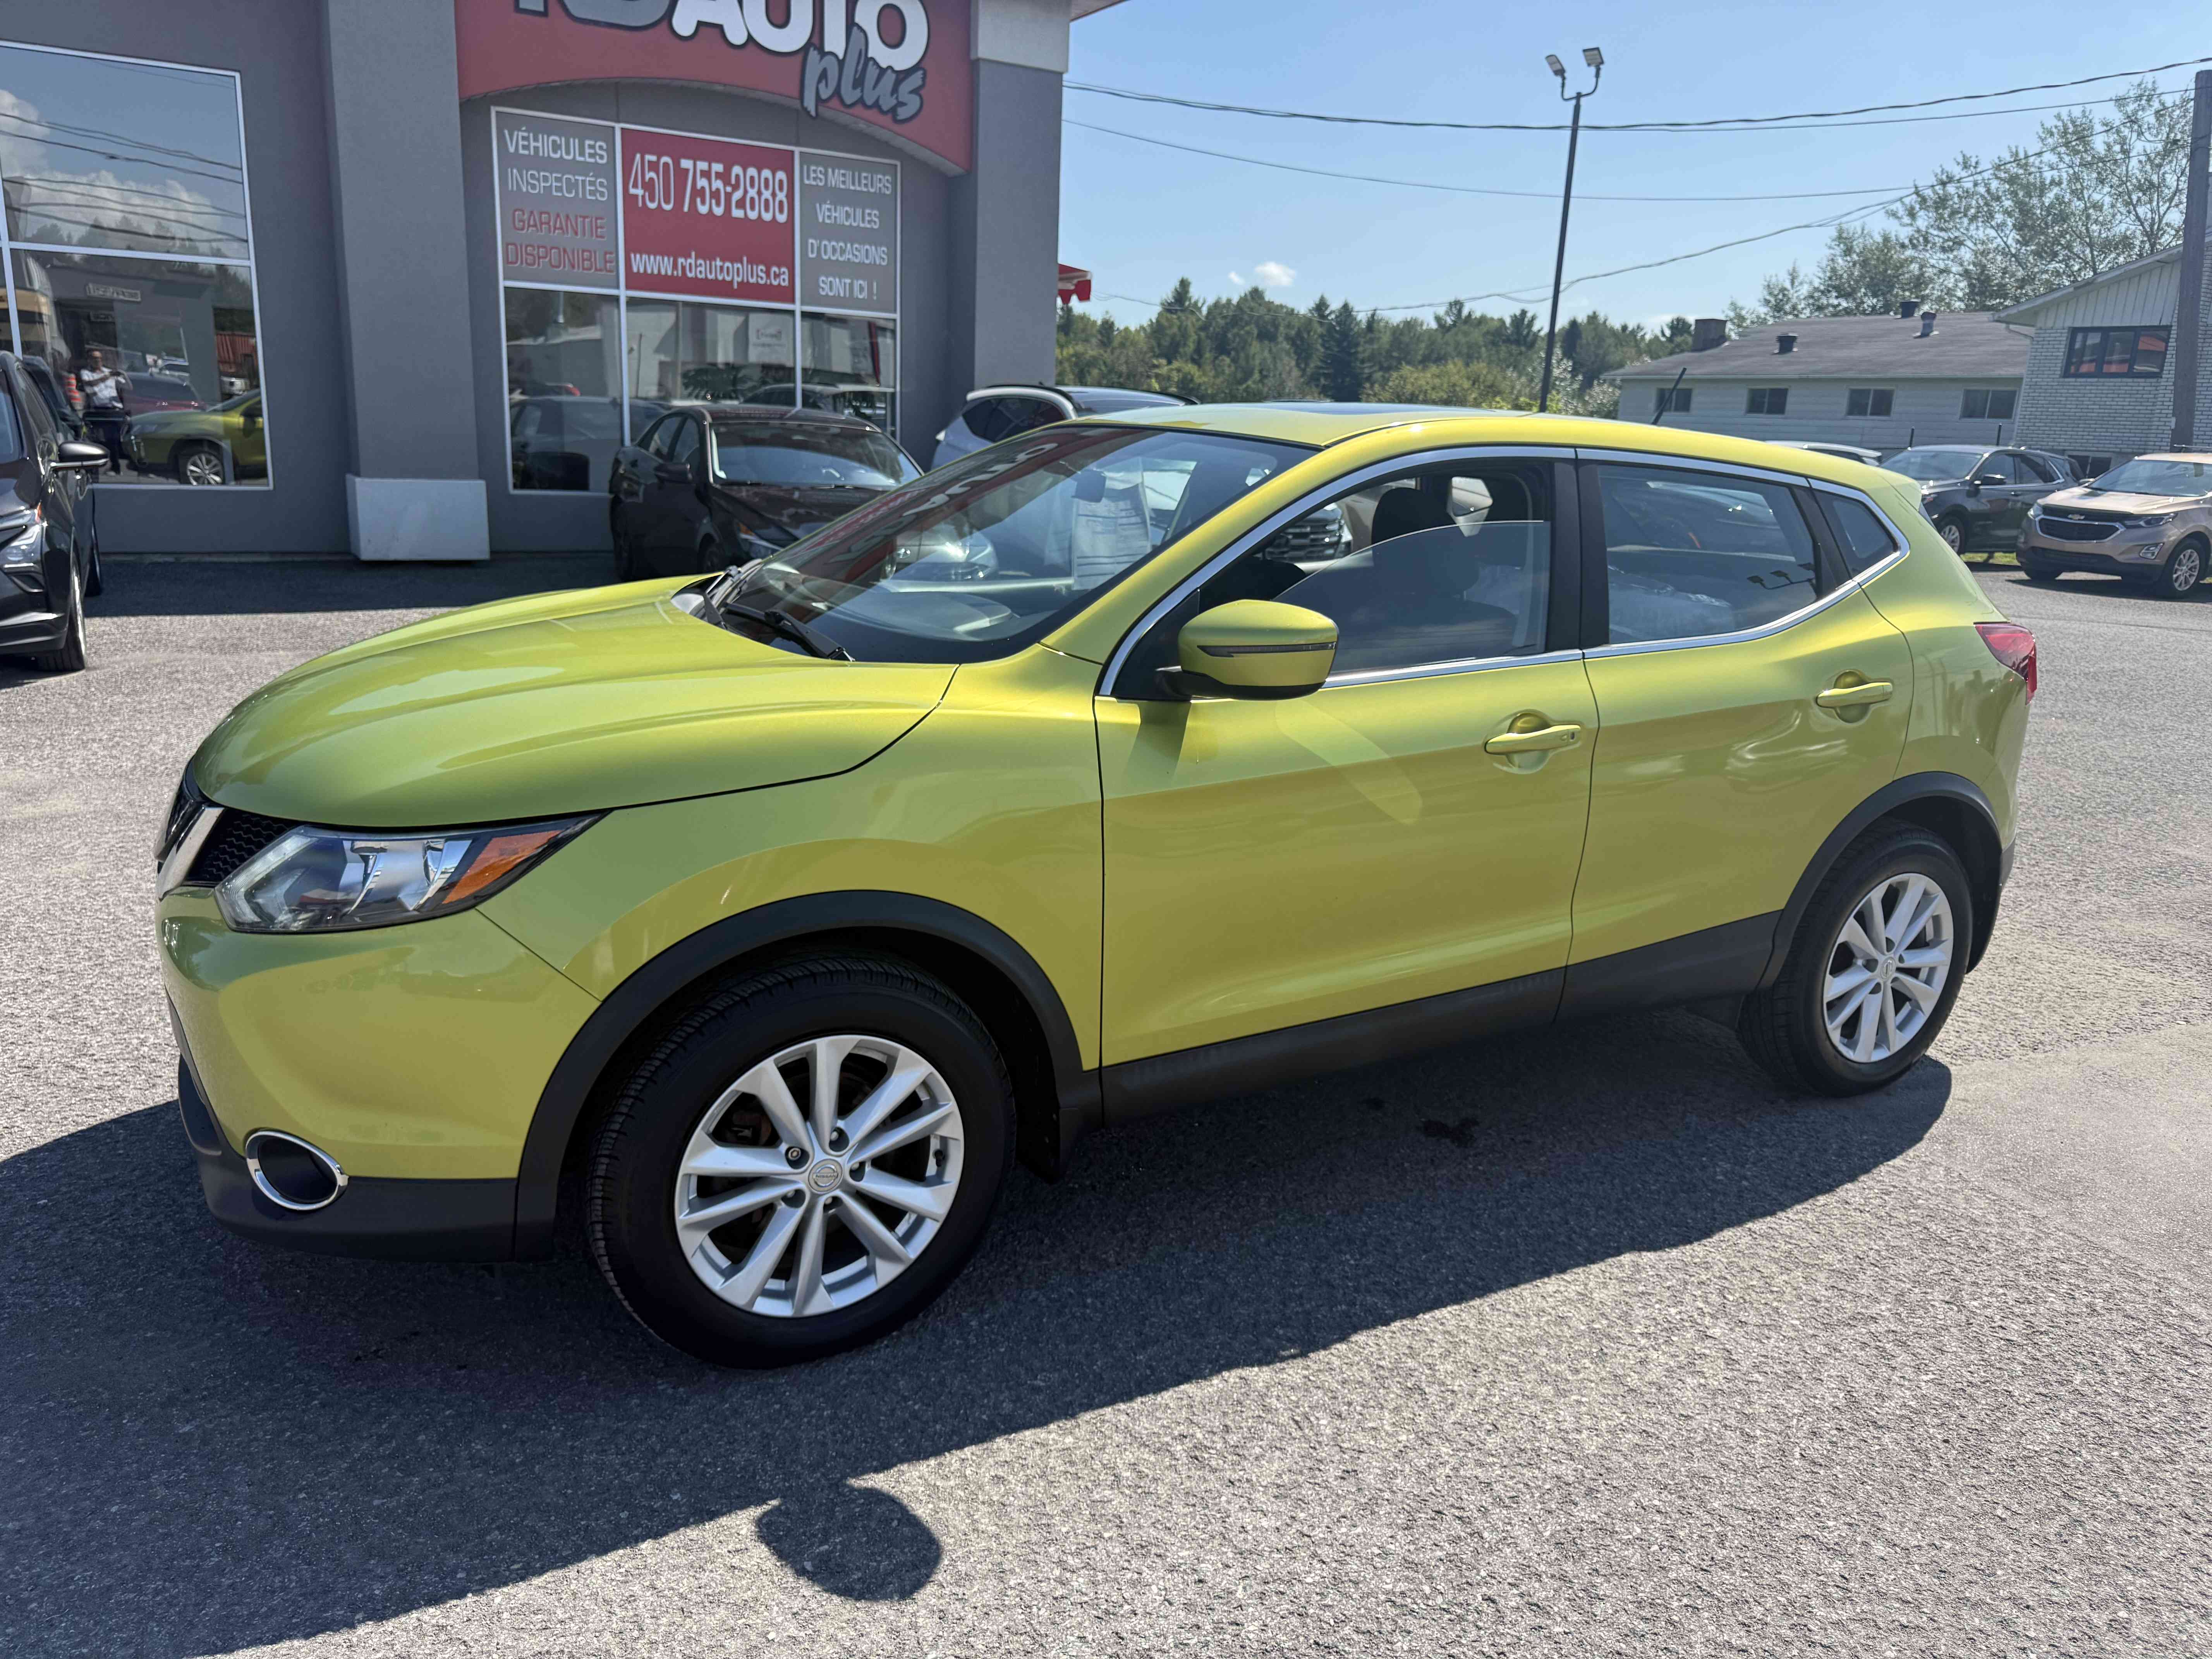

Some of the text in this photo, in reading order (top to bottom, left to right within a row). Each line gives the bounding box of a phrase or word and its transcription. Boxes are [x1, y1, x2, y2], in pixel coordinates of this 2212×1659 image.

[802, 24, 925, 122] plus
[504, 126, 608, 164] VÉHICULES
[507, 167, 608, 201] INSPECTÉS
[628, 153, 788, 223] 450 755-2888
[803, 165, 892, 194] LES MEILLEURS
[512, 208, 607, 240] GARANTIE
[815, 200, 880, 229] VÉHICULES
[505, 242, 616, 275] DISPONIBLE
[808, 238, 888, 266] D'OCCASIONS
[630, 250, 789, 289] www.rdautoplus.ca
[818, 276, 852, 298] SONT
[854, 279, 867, 300] ICI
